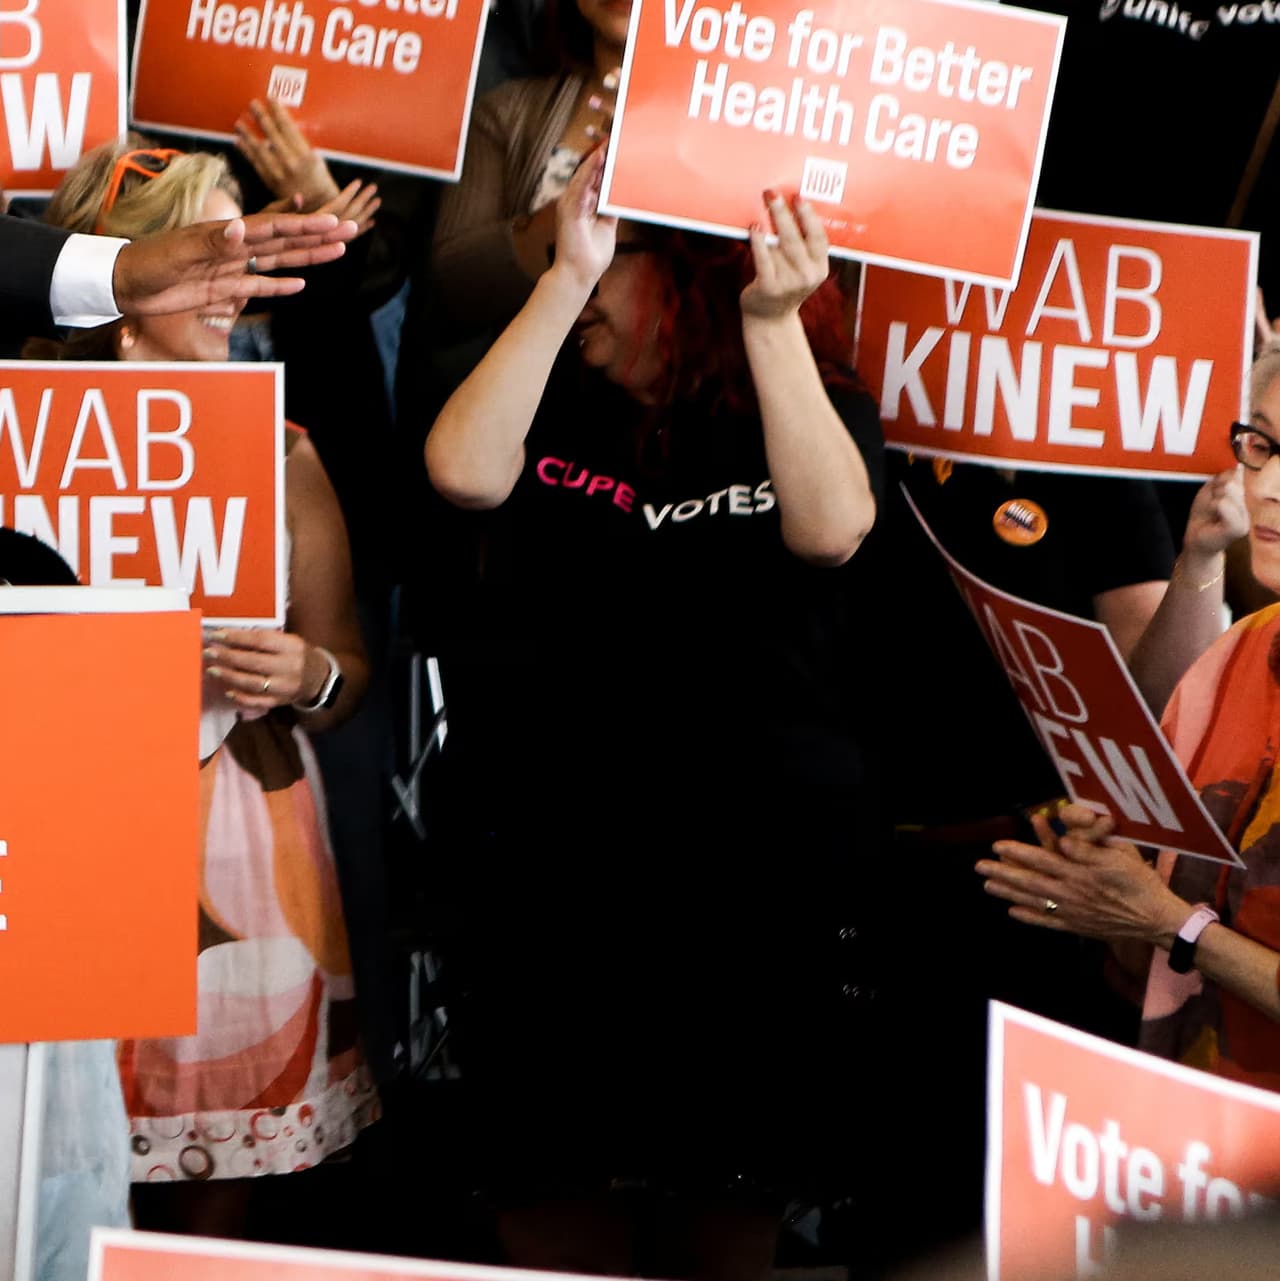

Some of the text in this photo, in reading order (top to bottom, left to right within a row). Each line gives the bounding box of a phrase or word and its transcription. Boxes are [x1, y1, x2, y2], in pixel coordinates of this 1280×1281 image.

[270, 76, 301, 99] NDP
[321, 7, 424, 75] Care
[786, 9, 863, 81] for
[869, 25, 1034, 112] Better
[687, 58, 980, 171] Health Care
[805, 168, 842, 196] NDP
[880, 322, 1214, 457] KINEW
[536, 456, 777, 531] CUPE VOTES
[983, 602, 1089, 724] AB
[1024, 1081, 1262, 1222] Vote fo
